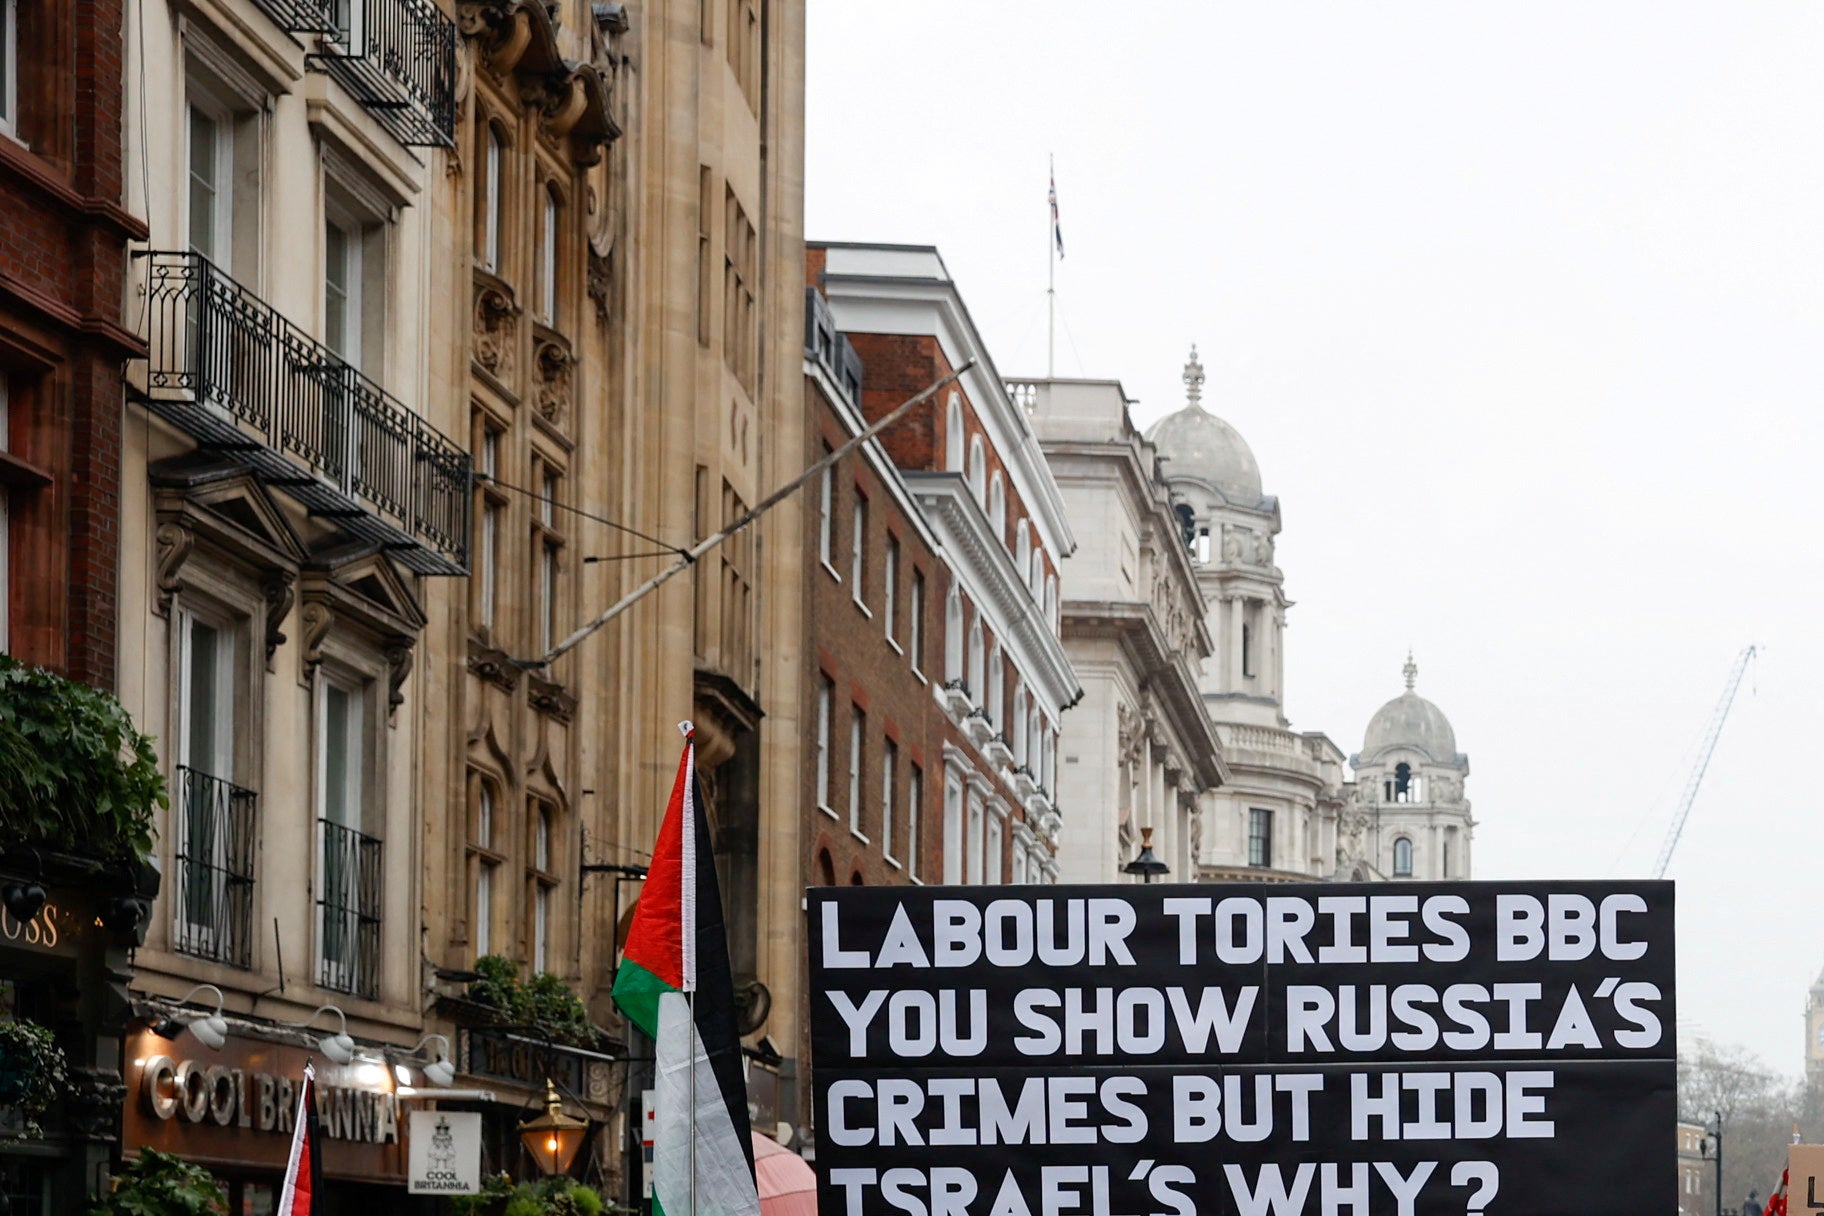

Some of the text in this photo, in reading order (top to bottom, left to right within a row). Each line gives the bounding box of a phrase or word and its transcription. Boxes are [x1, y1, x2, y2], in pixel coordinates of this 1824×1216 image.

[821, 893, 1648, 969] LABOUR TORIES BBC
[825, 977, 1662, 1058] YOU SHOW RUSSIA'S
[143, 1054, 250, 1127] COOL
[827, 1070, 1555, 1147] CRIMES BUT HIDE
[414, 1181, 470, 1191] BRITANNIA
[426, 1171, 457, 1180] COOL
